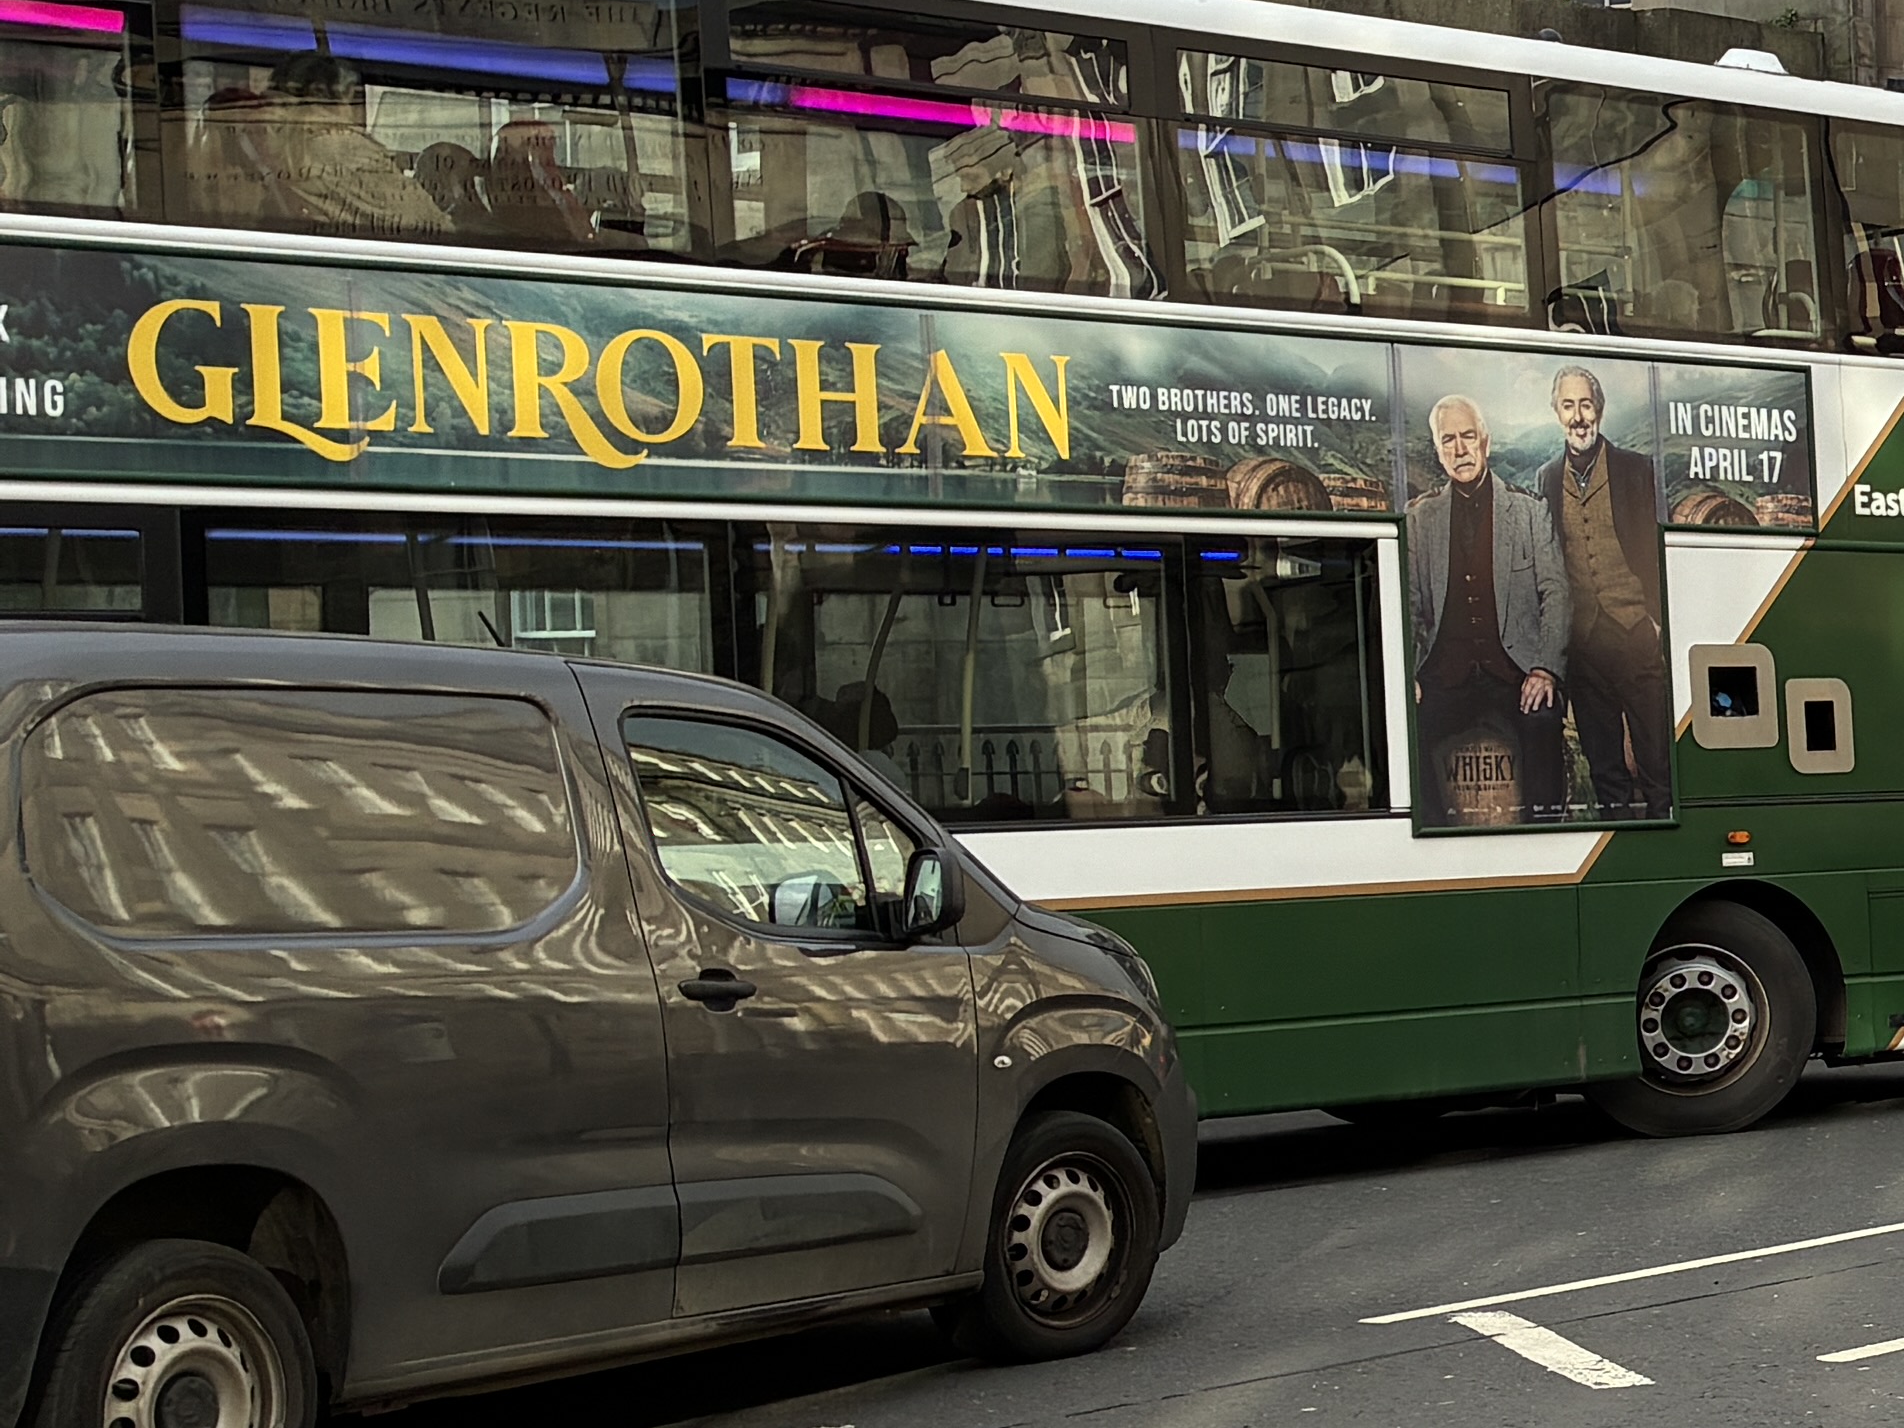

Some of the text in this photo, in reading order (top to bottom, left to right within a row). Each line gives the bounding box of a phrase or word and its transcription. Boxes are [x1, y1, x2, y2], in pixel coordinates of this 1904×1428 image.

[128, 298, 1071, 469] GLENROTHAN
[1109, 384, 1376, 422] TWO BROTHERS. ONE LEGACY.
[1176, 418, 1319, 448] LOTS OF SPIRIT.
[1669, 401, 1798, 443] IN CINEMAS
[1688, 445, 1783, 484] APRIL 17
